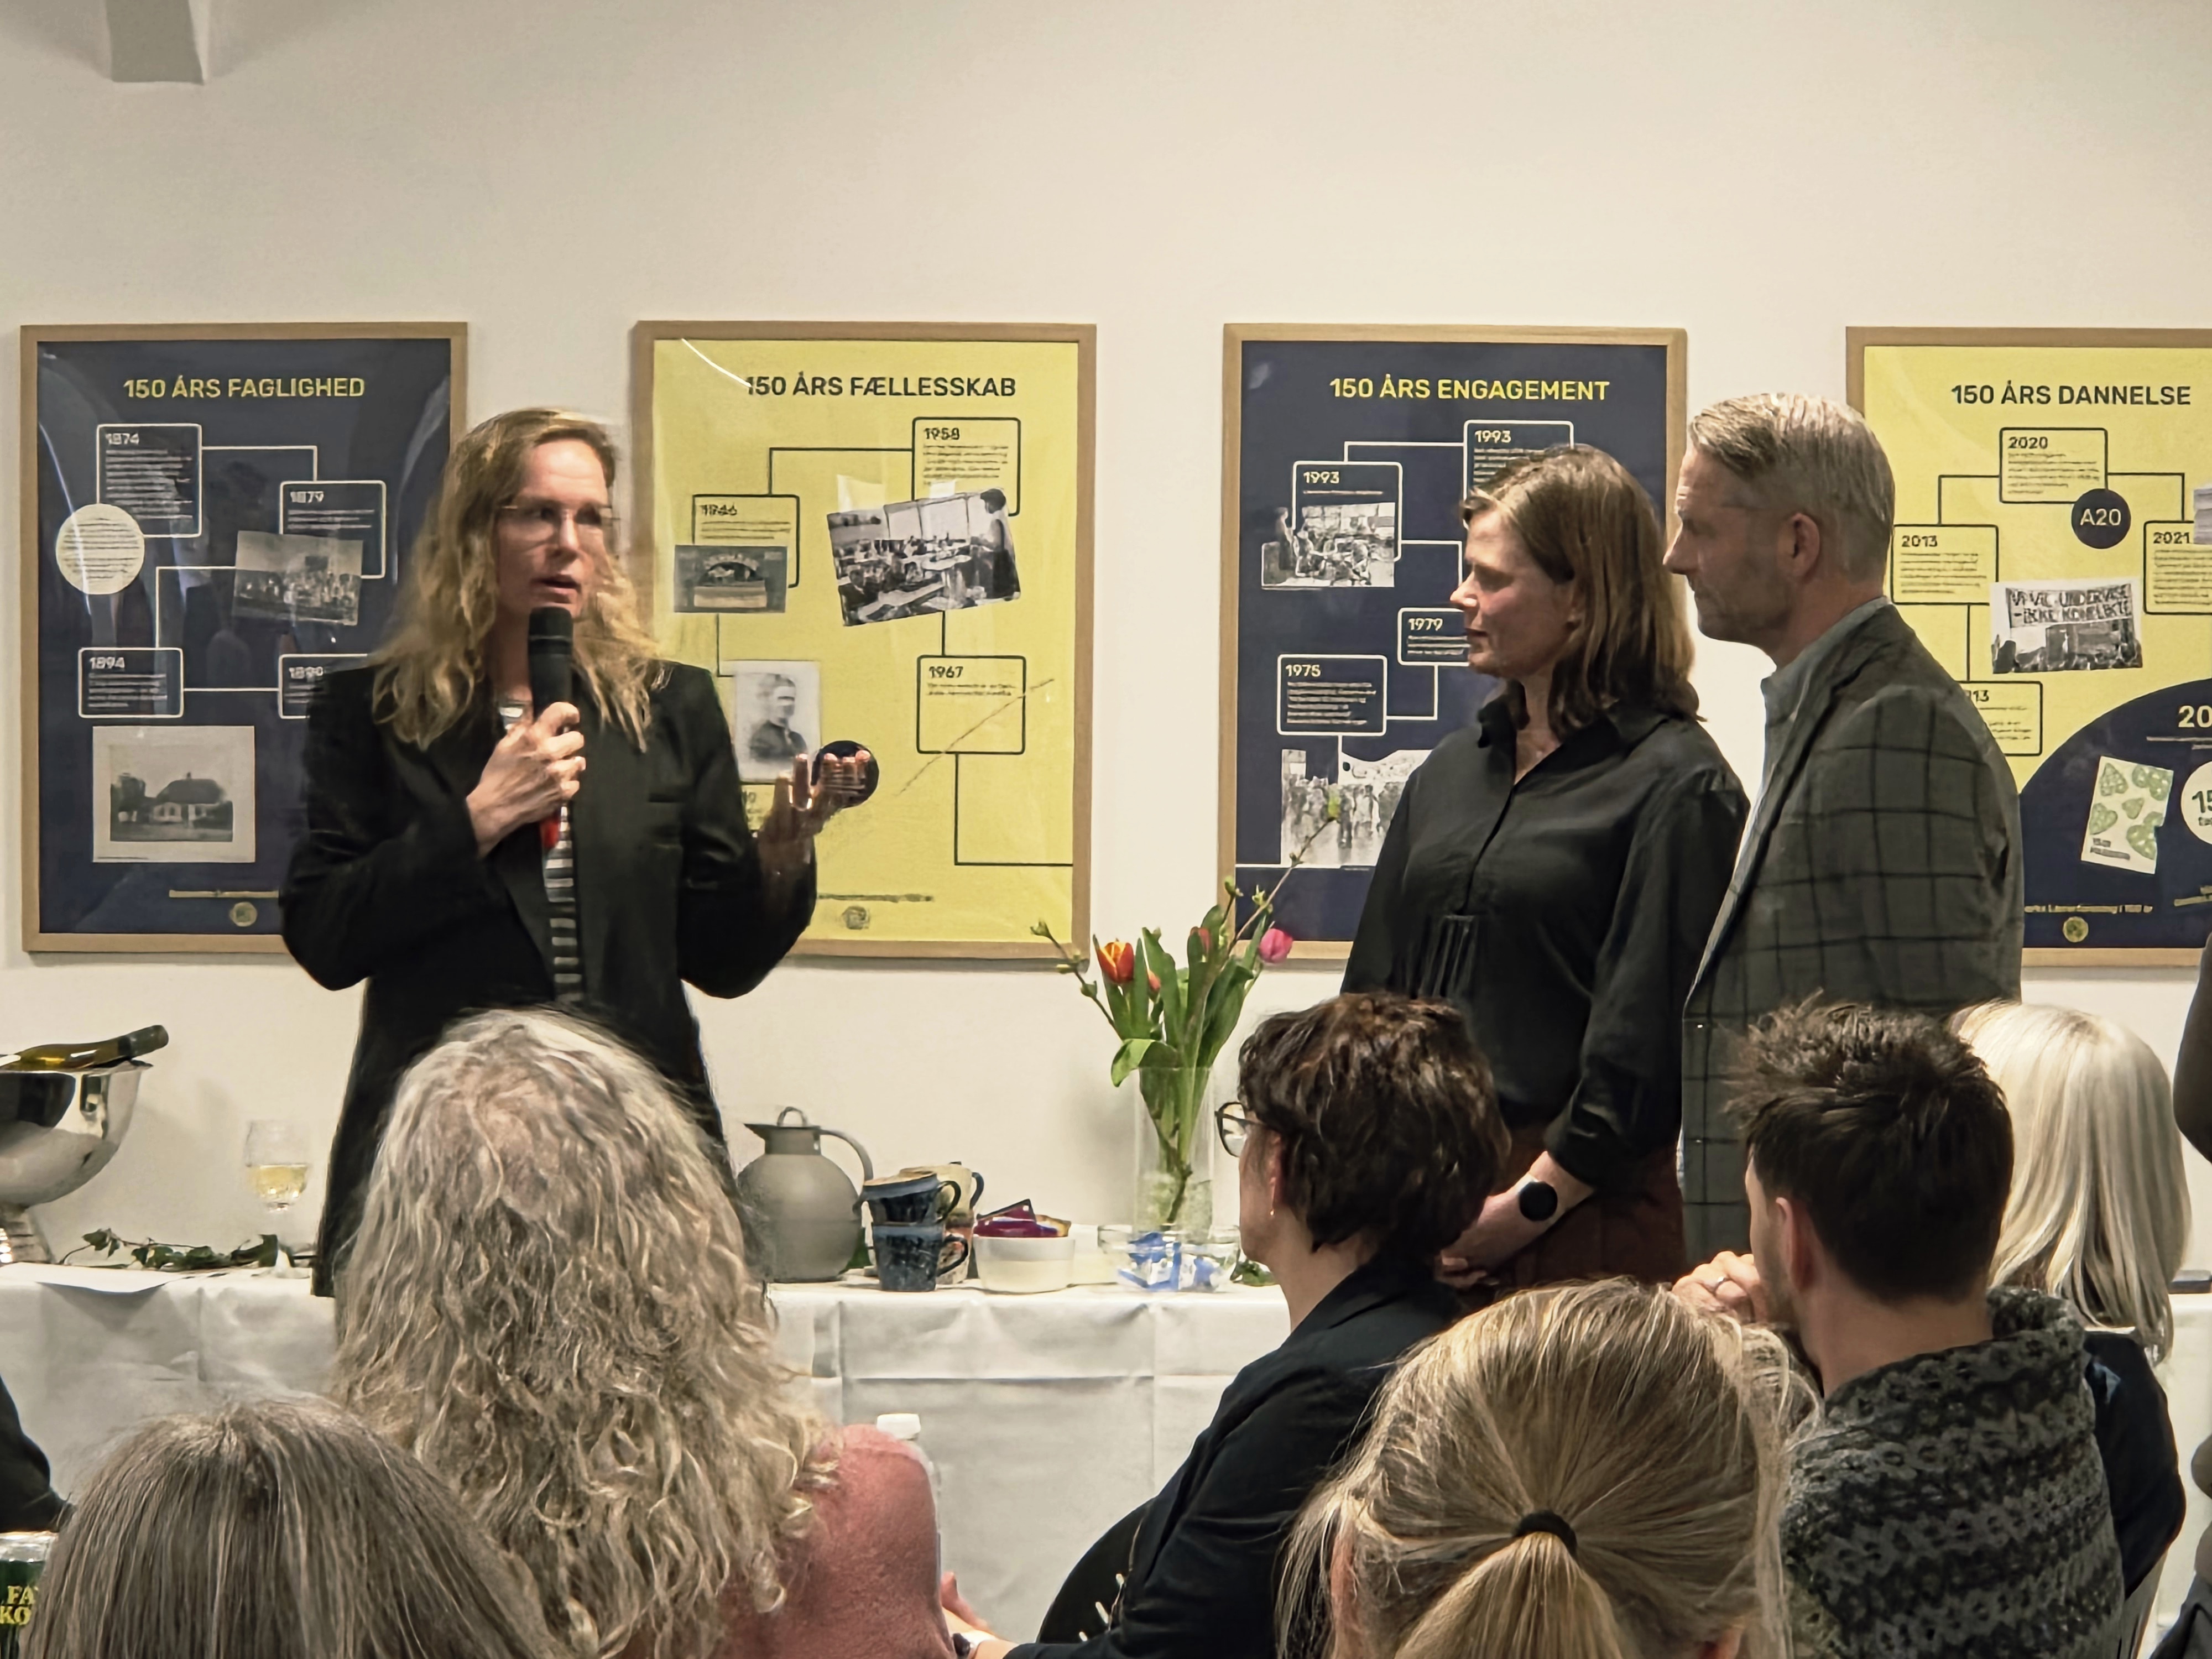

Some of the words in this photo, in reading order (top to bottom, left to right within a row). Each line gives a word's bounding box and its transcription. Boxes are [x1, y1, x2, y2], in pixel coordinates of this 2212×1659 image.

[123, 379, 166, 398] 150
[171, 374, 221, 398] ÅRS
[228, 377, 365, 398] FAGLIGHED
[745, 376, 786, 396] 150
[792, 371, 843, 397] ÅRS
[850, 376, 1016, 397] FÆLLESSKAB
[1329, 377, 1373, 398] 150
[1379, 373, 1431, 399] ÅRS
[1437, 378, 1610, 400] ENGAGEMENT
[1951, 384, 1994, 405] 150
[2000, 379, 2051, 405] ÅRS
[2059, 385, 2191, 405] DANNELSE
[105, 432, 140, 445] 1874
[923, 427, 960, 441] 1958
[1474, 429, 1512, 444] 1993
[2008, 436, 2048, 449] 2020
[1303, 471, 1340, 484] 1993
[2080, 508, 2122, 526] A20
[1901, 535, 1938, 547] 2013
[2153, 531, 2190, 544] 2021
[1407, 618, 1443, 632] 1979
[928, 665, 964, 679] 1967
[1285, 664, 1321, 677] 1975
[7, 1585, 39, 1605] FA
